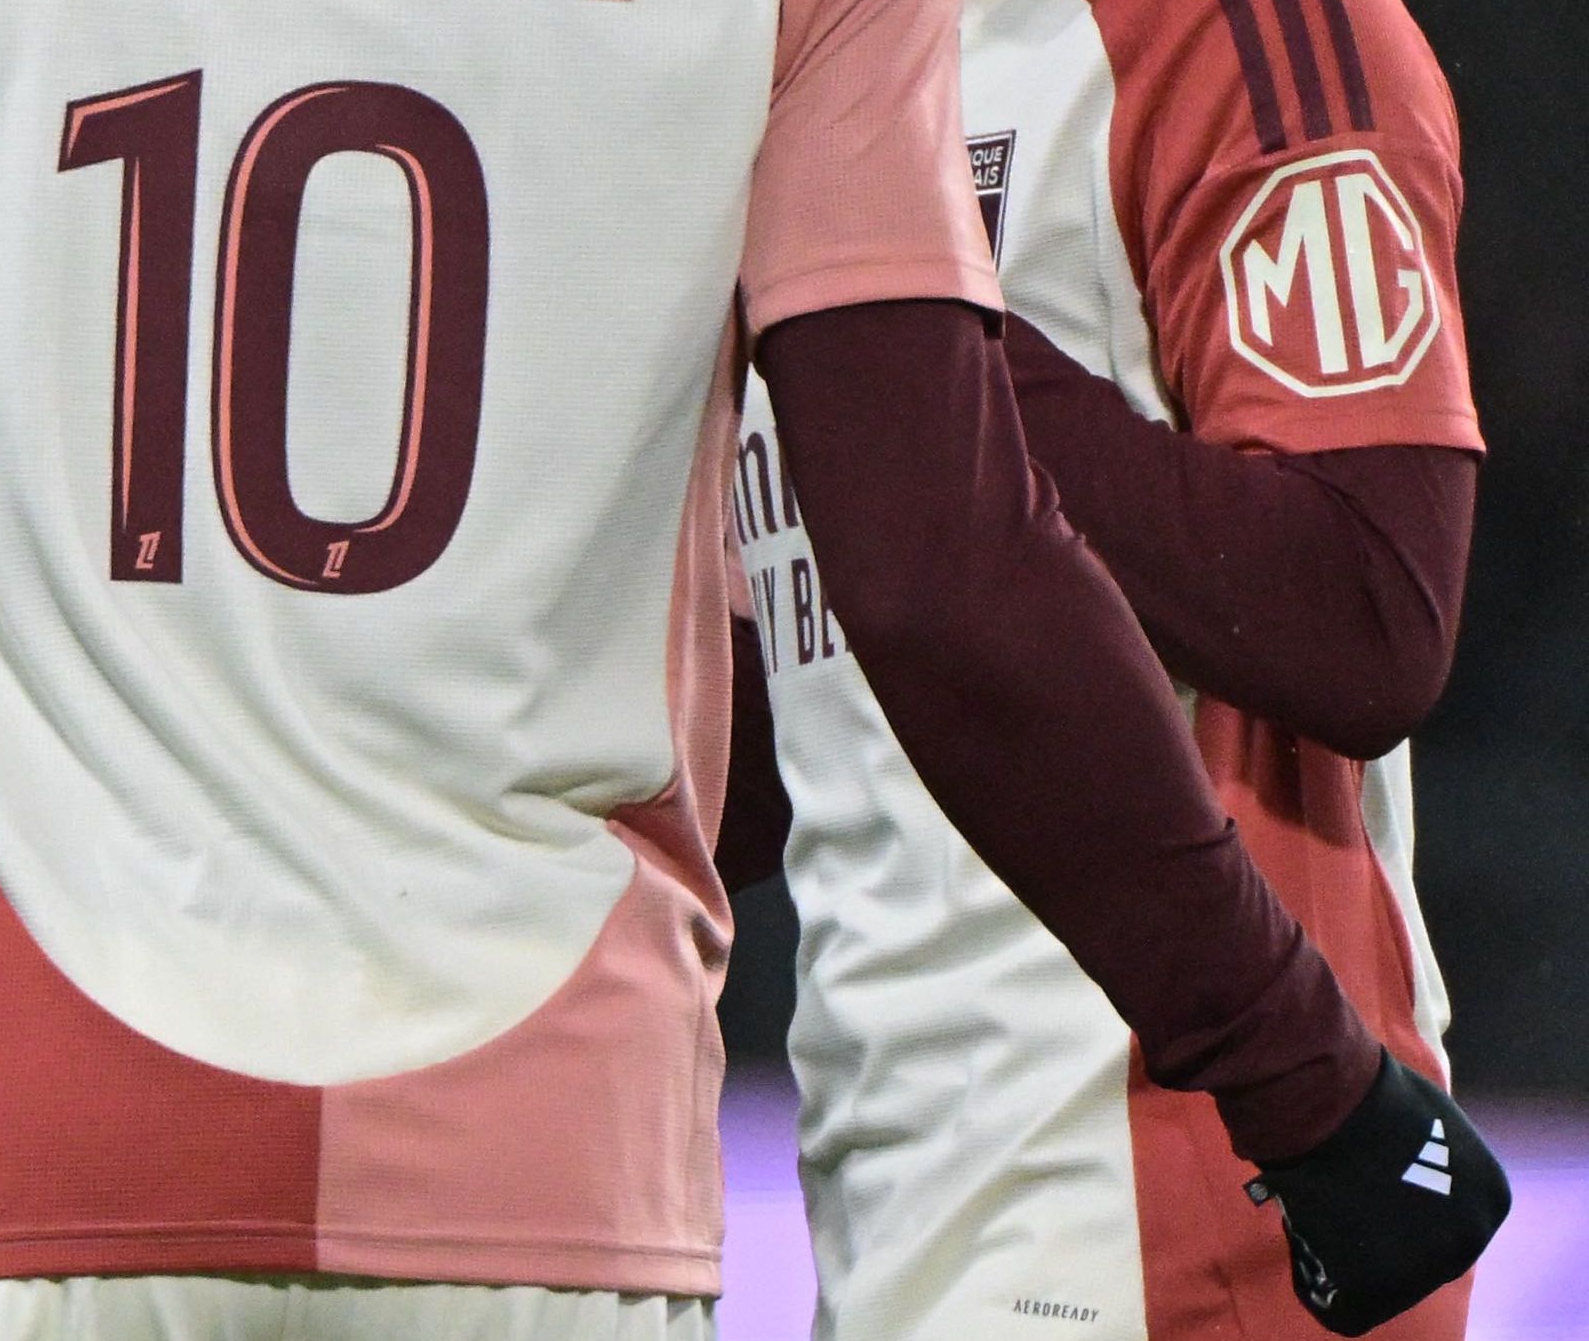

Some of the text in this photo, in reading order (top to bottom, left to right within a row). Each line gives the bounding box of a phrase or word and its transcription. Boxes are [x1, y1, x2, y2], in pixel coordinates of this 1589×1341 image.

[57, 68, 491, 595] 10
[1241, 172, 1424, 375] MG
[1013, 1298, 1099, 1322] AEROREADY
